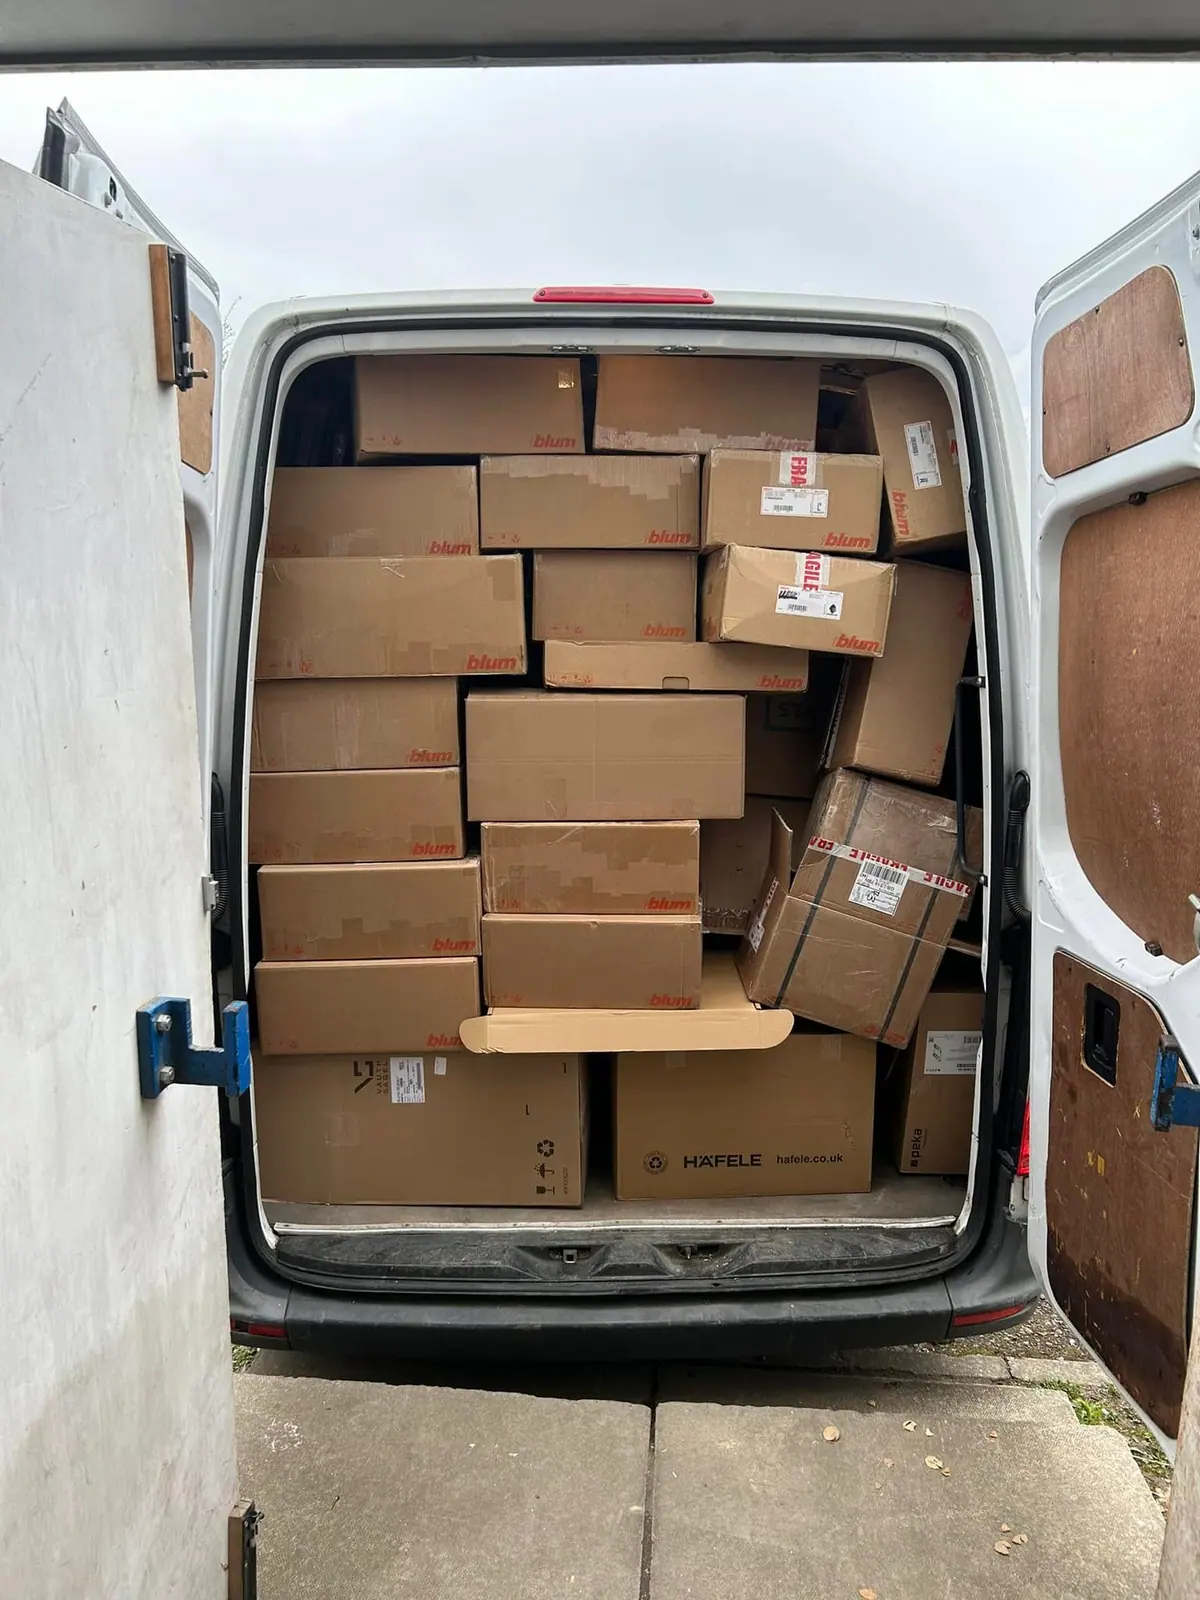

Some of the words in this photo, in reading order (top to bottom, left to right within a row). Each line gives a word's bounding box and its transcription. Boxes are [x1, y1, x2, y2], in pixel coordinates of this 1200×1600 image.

[534, 434, 577, 449] blum
[649, 530, 692, 544] blum
[824, 532, 871, 549] blum
[429, 541, 473, 555] blum
[644, 624, 687, 637] blum
[834, 634, 880, 651] blum
[465, 654, 518, 671] blum
[760, 675, 804, 689] blum
[409, 749, 453, 763] blum
[412, 842, 457, 856] blum
[648, 897, 692, 911] blum
[432, 938, 476, 952] blum
[650, 993, 693, 1008] blum
[426, 1033, 463, 1048] blu
[911, 1127, 922, 1159] peka
[683, 1153, 762, 1169] HÄFELE
[776, 1152, 844, 1165] hafele.co.uk
